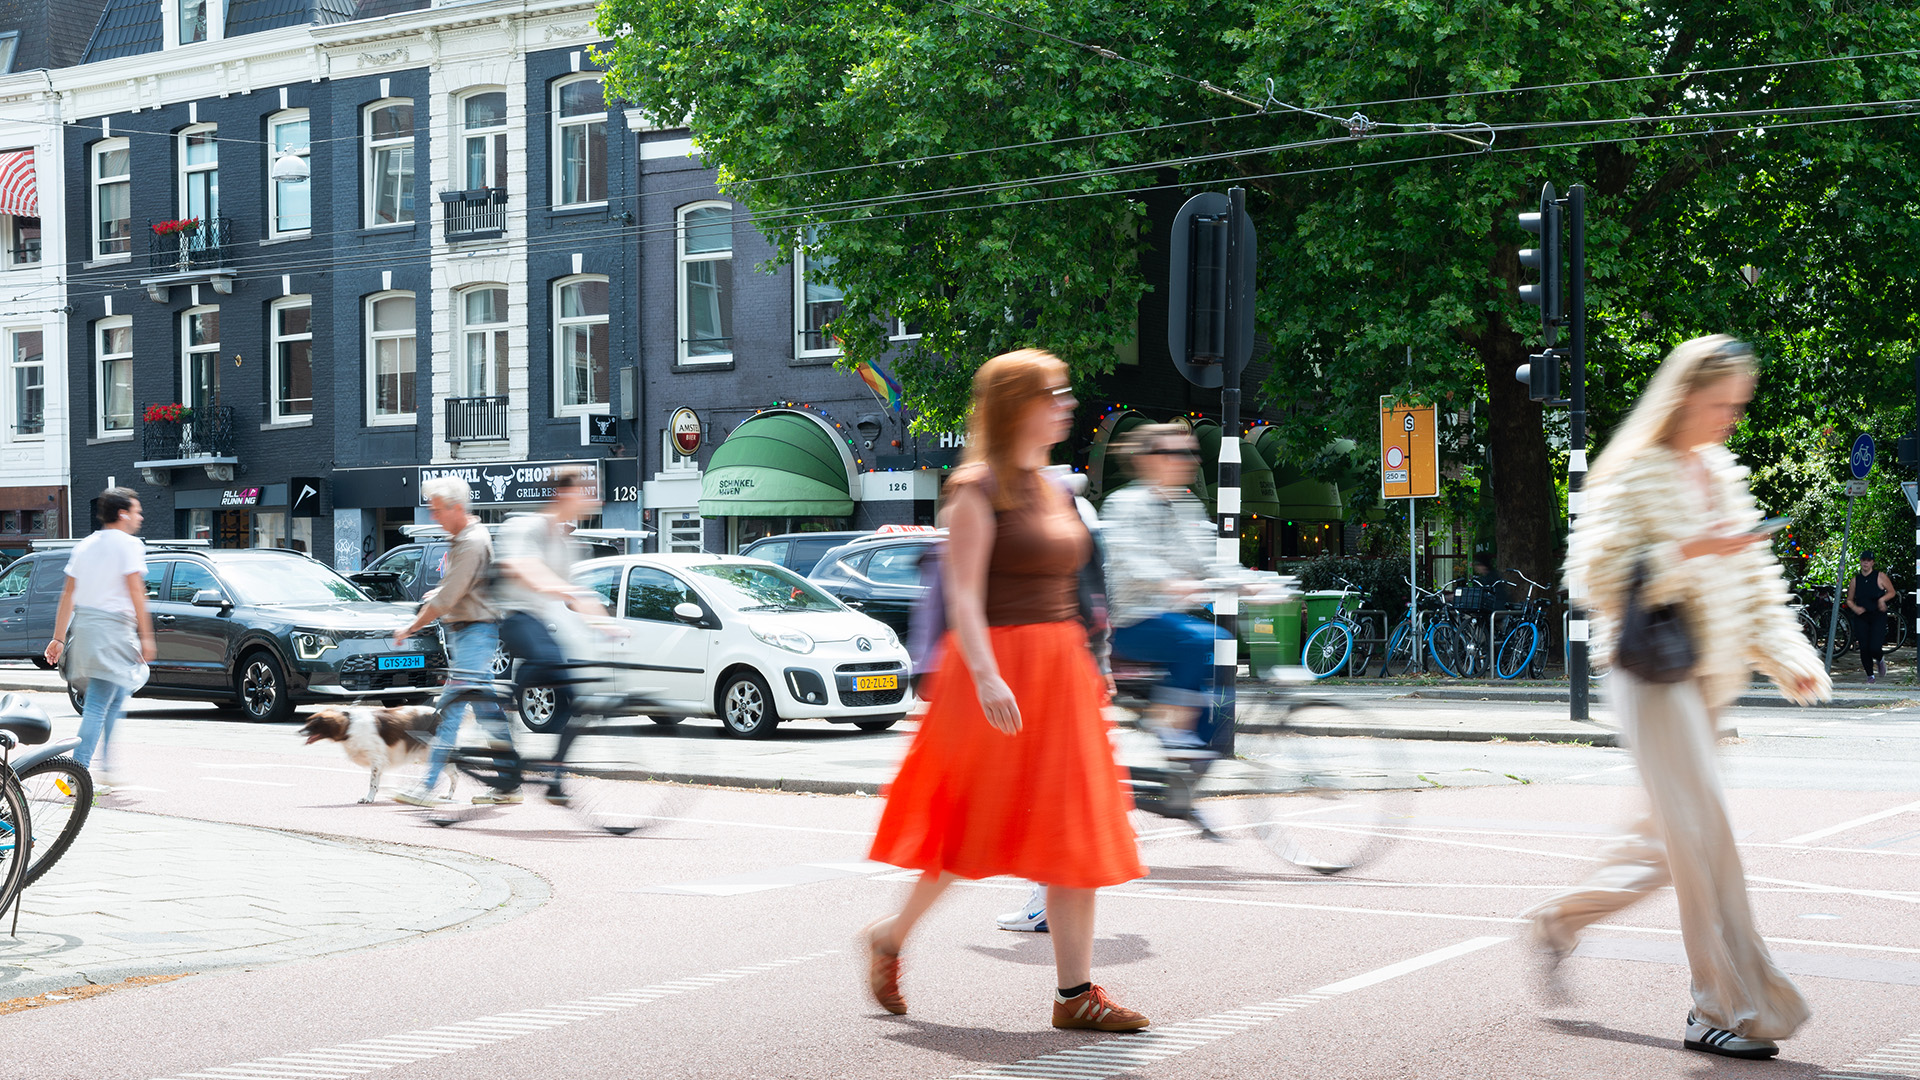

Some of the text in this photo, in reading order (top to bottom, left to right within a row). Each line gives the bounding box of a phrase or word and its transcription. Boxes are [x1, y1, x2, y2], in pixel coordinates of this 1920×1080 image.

[516, 467, 552, 483] CHOP
[719, 479, 755, 489] SCHINKEL
[889, 483, 907, 491] 126
[516, 488, 540, 498] GRILL
[613, 486, 637, 502] 128
[384, 657, 420, 668] GTS-23-H
[860, 677, 894, 689] 02-ZLZ-5
